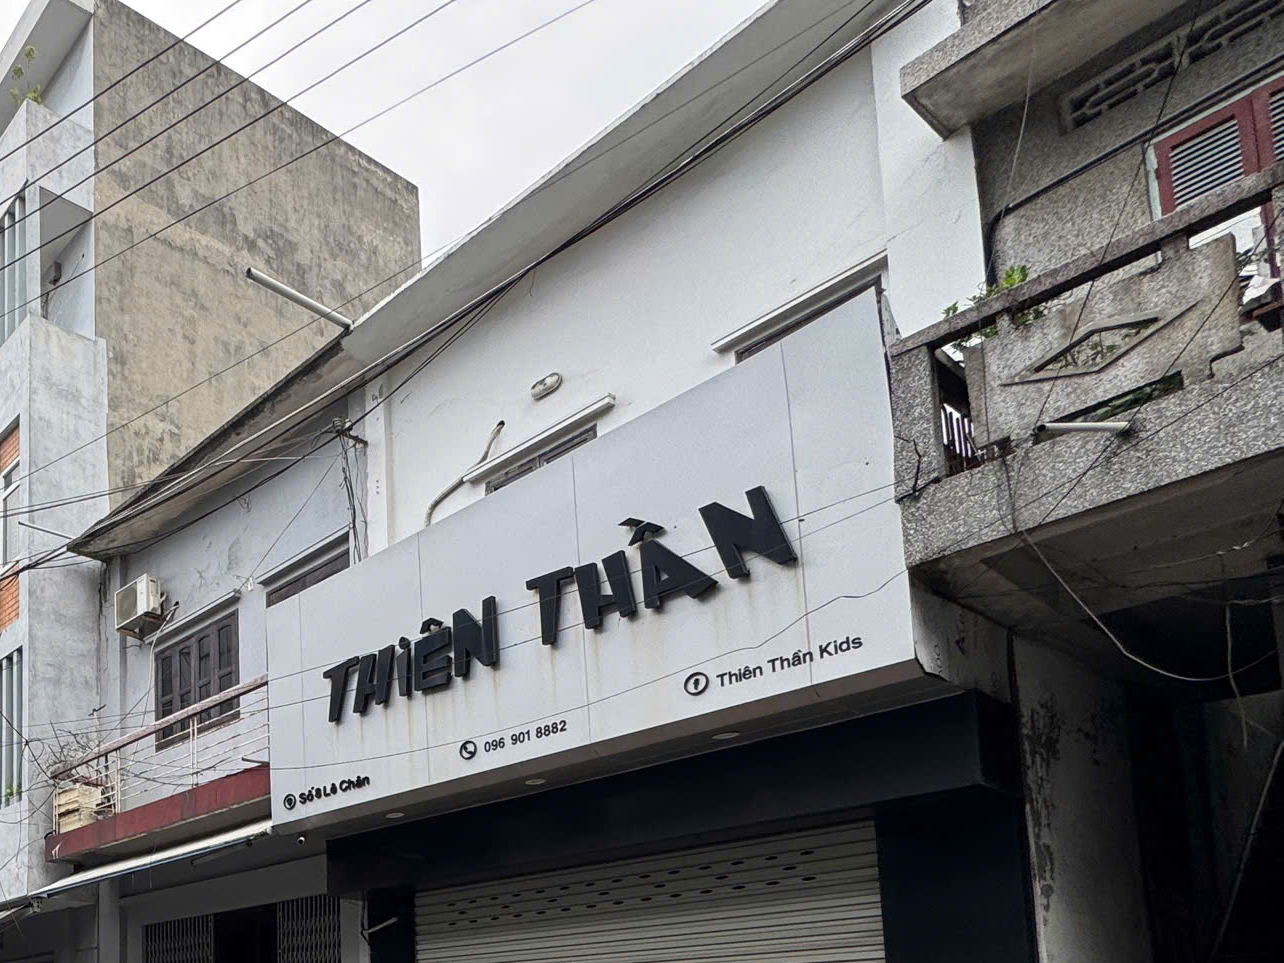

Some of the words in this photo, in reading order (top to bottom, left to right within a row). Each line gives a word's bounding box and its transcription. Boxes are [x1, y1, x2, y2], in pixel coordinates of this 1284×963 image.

[526, 485, 798, 646] THẦN
[716, 664, 764, 688] Thiên
[767, 649, 814, 674] Thần
[818, 635, 864, 660] Kids
[483, 737, 506, 753] 096
[510, 729, 531, 746] 901
[535, 719, 568, 739] 8882
[298, 786, 315, 805] Số
[323, 782, 338, 798] Lê
[339, 775, 371, 793] Chân
